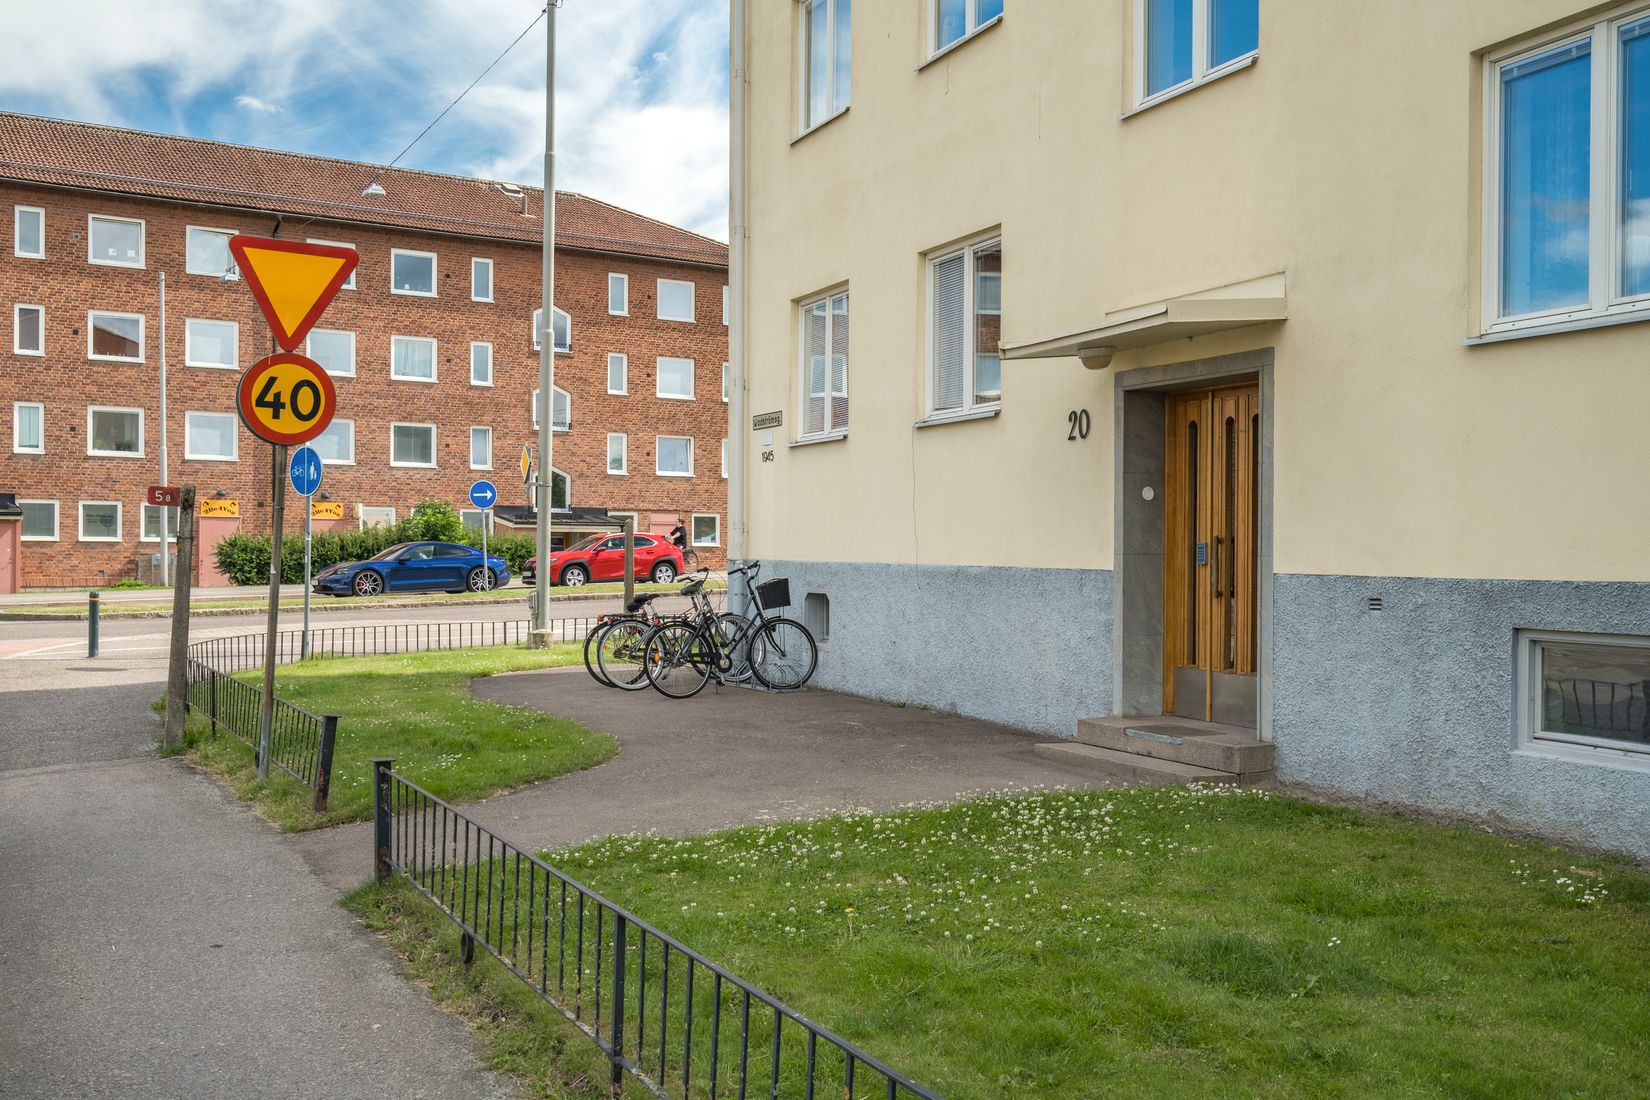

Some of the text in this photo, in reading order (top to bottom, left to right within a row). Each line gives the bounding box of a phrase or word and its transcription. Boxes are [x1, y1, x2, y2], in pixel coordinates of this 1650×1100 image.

[255, 375, 321, 422] 40
[1067, 408, 1090, 441] 20
[761, 450, 774, 462] 1945
